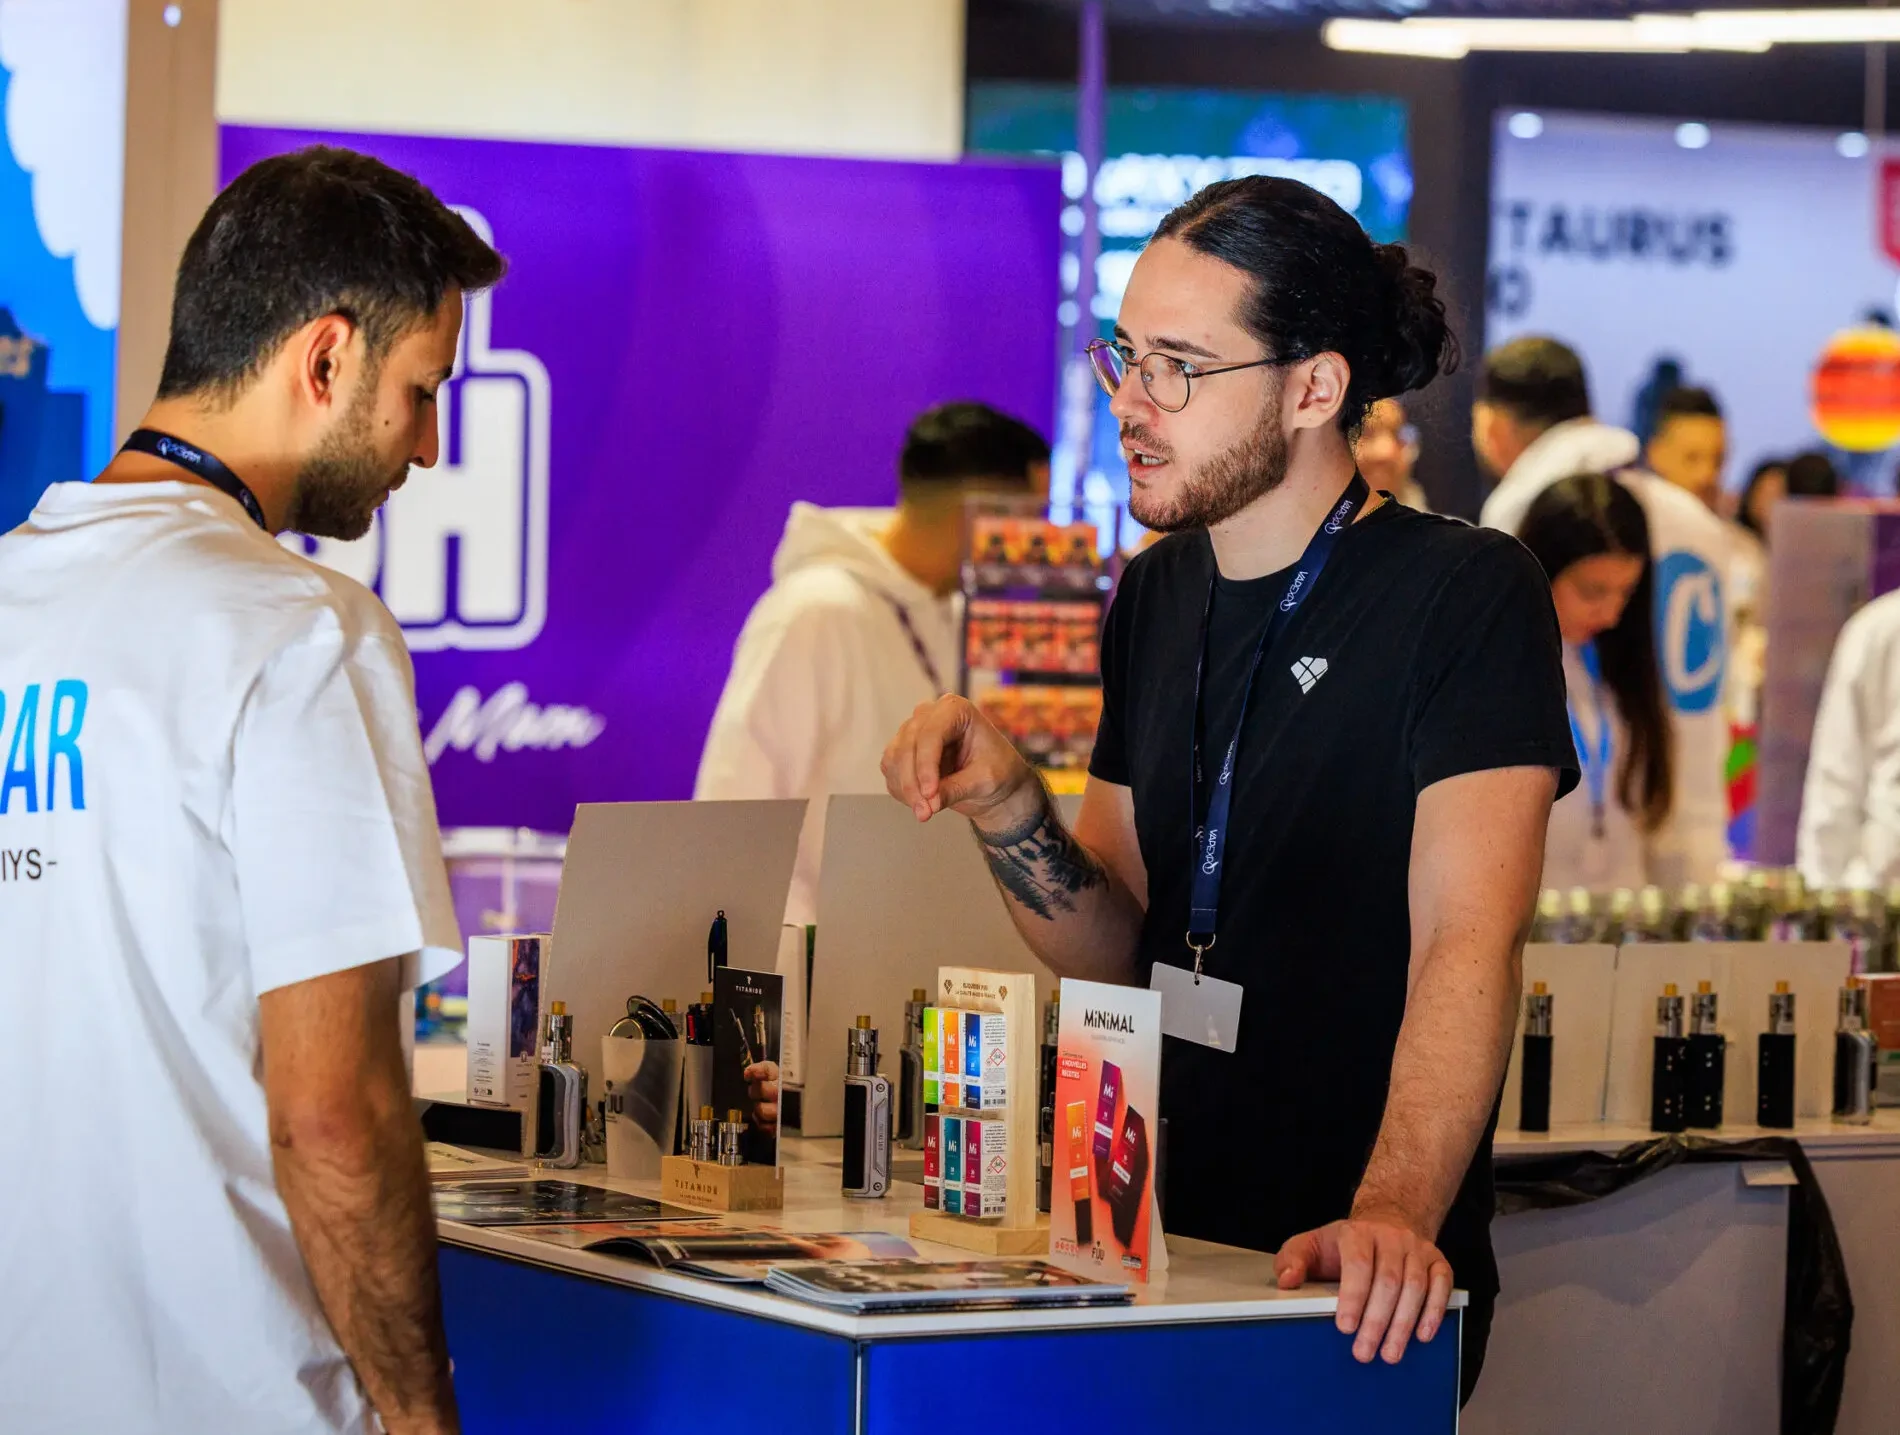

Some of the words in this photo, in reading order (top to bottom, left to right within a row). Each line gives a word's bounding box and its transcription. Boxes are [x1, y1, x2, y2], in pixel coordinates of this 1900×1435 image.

[1279, 570, 1309, 612] VAPEXPO
[0, 678, 88, 815] AR
[1202, 829, 1220, 875] VAPEXPO
[735, 985, 763, 995] TITANIDE
[674, 1180, 718, 1195] TITANIDE
